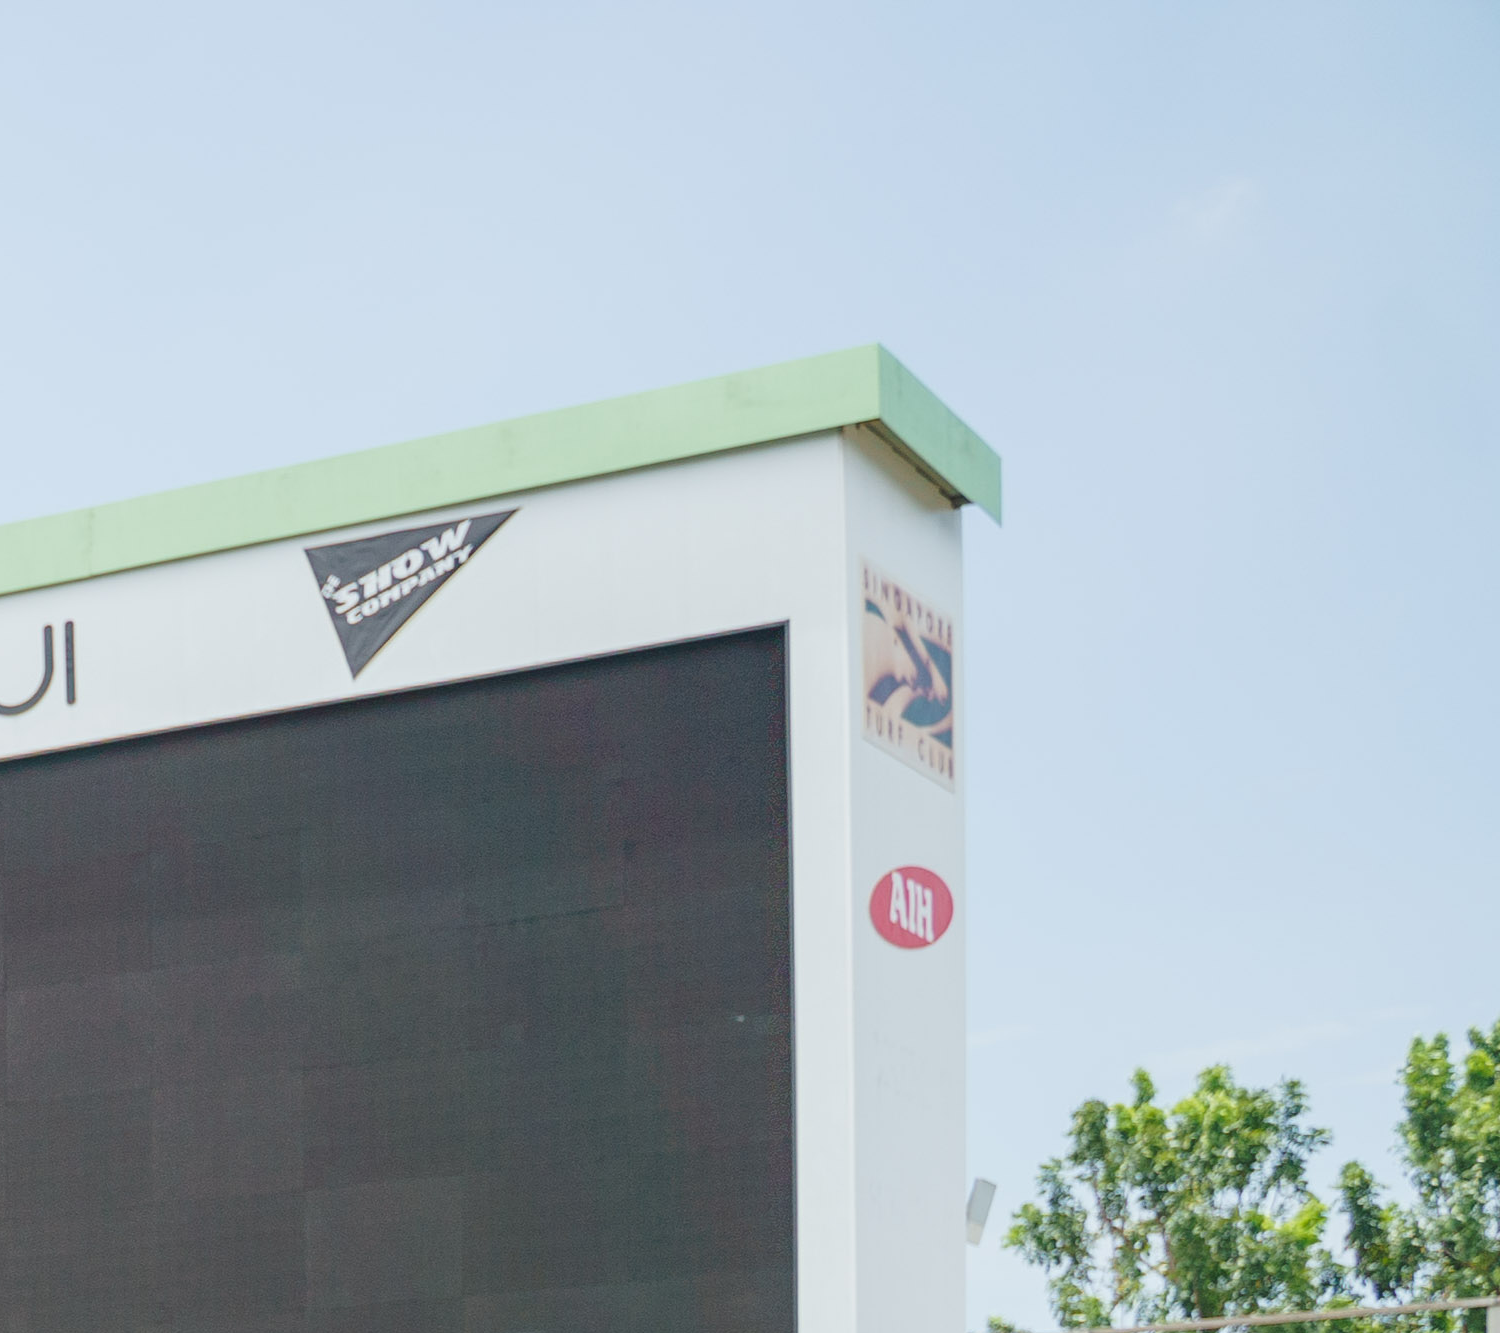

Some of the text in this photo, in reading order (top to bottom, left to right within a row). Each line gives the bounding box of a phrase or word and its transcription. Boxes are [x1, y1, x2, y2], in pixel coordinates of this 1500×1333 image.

[334, 518, 472, 615] SHOW
[346, 544, 474, 625] COMPANY
[863, 567, 953, 647] SINGAPORE
[864, 705, 903, 747] TURF
